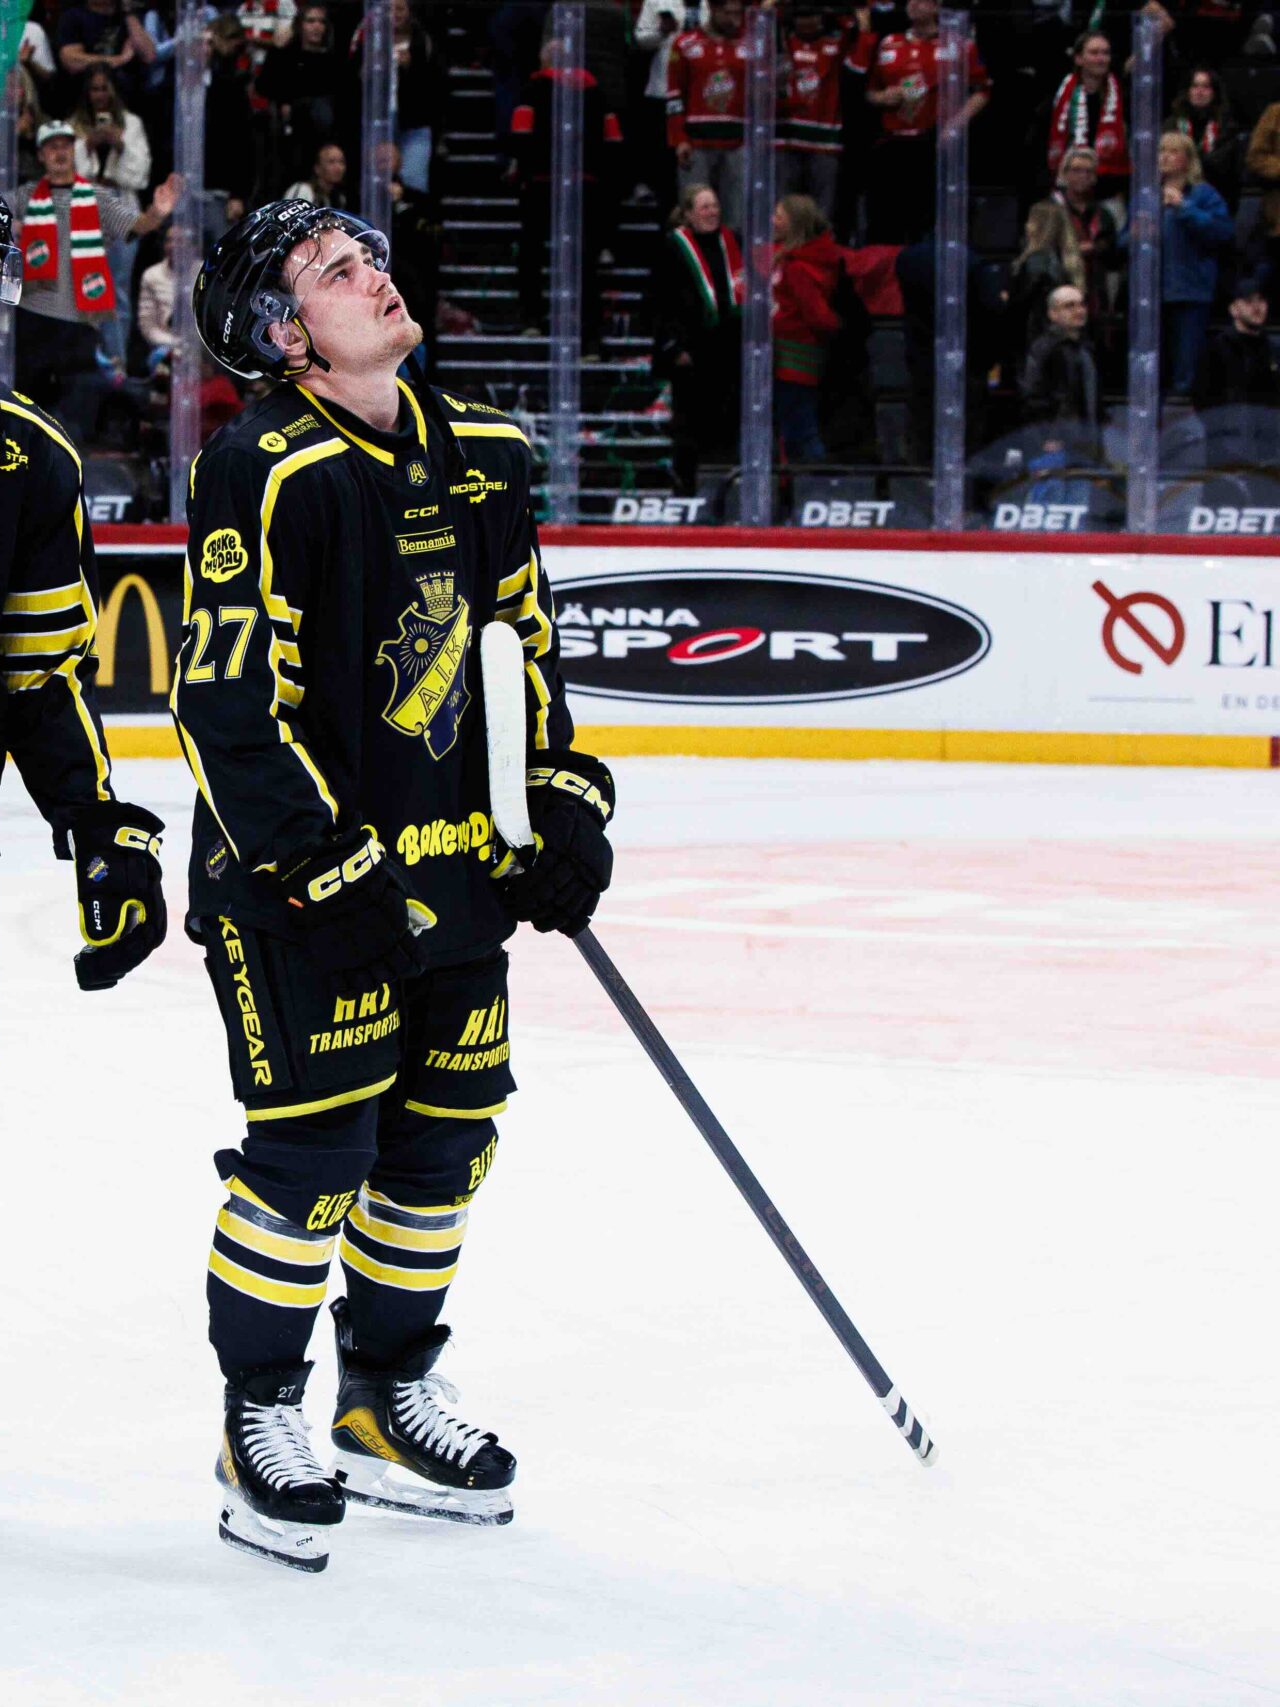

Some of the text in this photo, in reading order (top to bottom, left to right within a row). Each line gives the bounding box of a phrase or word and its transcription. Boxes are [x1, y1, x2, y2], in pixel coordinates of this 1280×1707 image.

[223, 312, 234, 344] CCM
[404, 504, 439, 519] CCM
[613, 497, 706, 522] DBET
[802, 501, 895, 527] DBET
[994, 504, 1088, 530] DBET
[1188, 507, 1280, 533] DBET
[556, 603, 700, 627] ÄNNA
[185, 606, 258, 684] 27
[560, 626, 928, 665] SPORT
[526, 767, 611, 821] CCM
[308, 838, 387, 902] CCM
[93, 900, 103, 931] CCM
[219, 914, 273, 1086] KEYGEAR
[277, 1385, 296, 1399] 27
[296, 1536, 313, 1547] CCM
